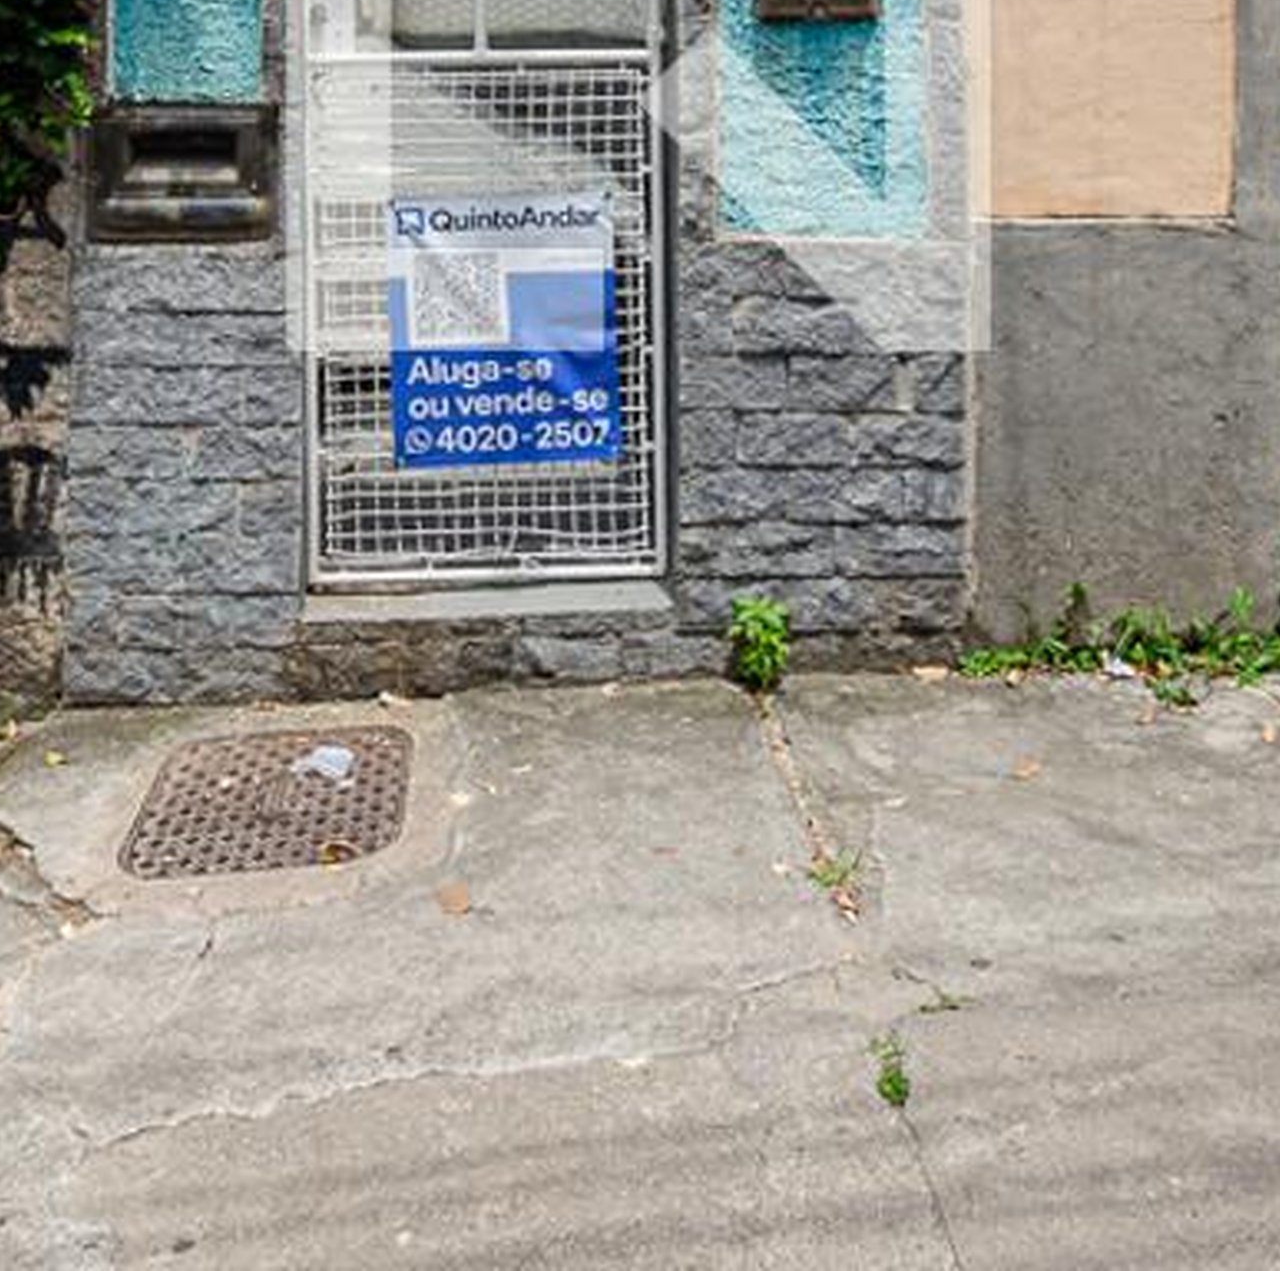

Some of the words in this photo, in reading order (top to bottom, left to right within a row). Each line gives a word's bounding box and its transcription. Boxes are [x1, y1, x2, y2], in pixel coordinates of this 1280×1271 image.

[429, 205, 600, 233] QuintoAndar
[407, 357, 553, 387] Aluga-se
[407, 400, 449, 419] ou
[455, 387, 609, 414] vende-se
[435, 420, 610, 452] 4020-2507
